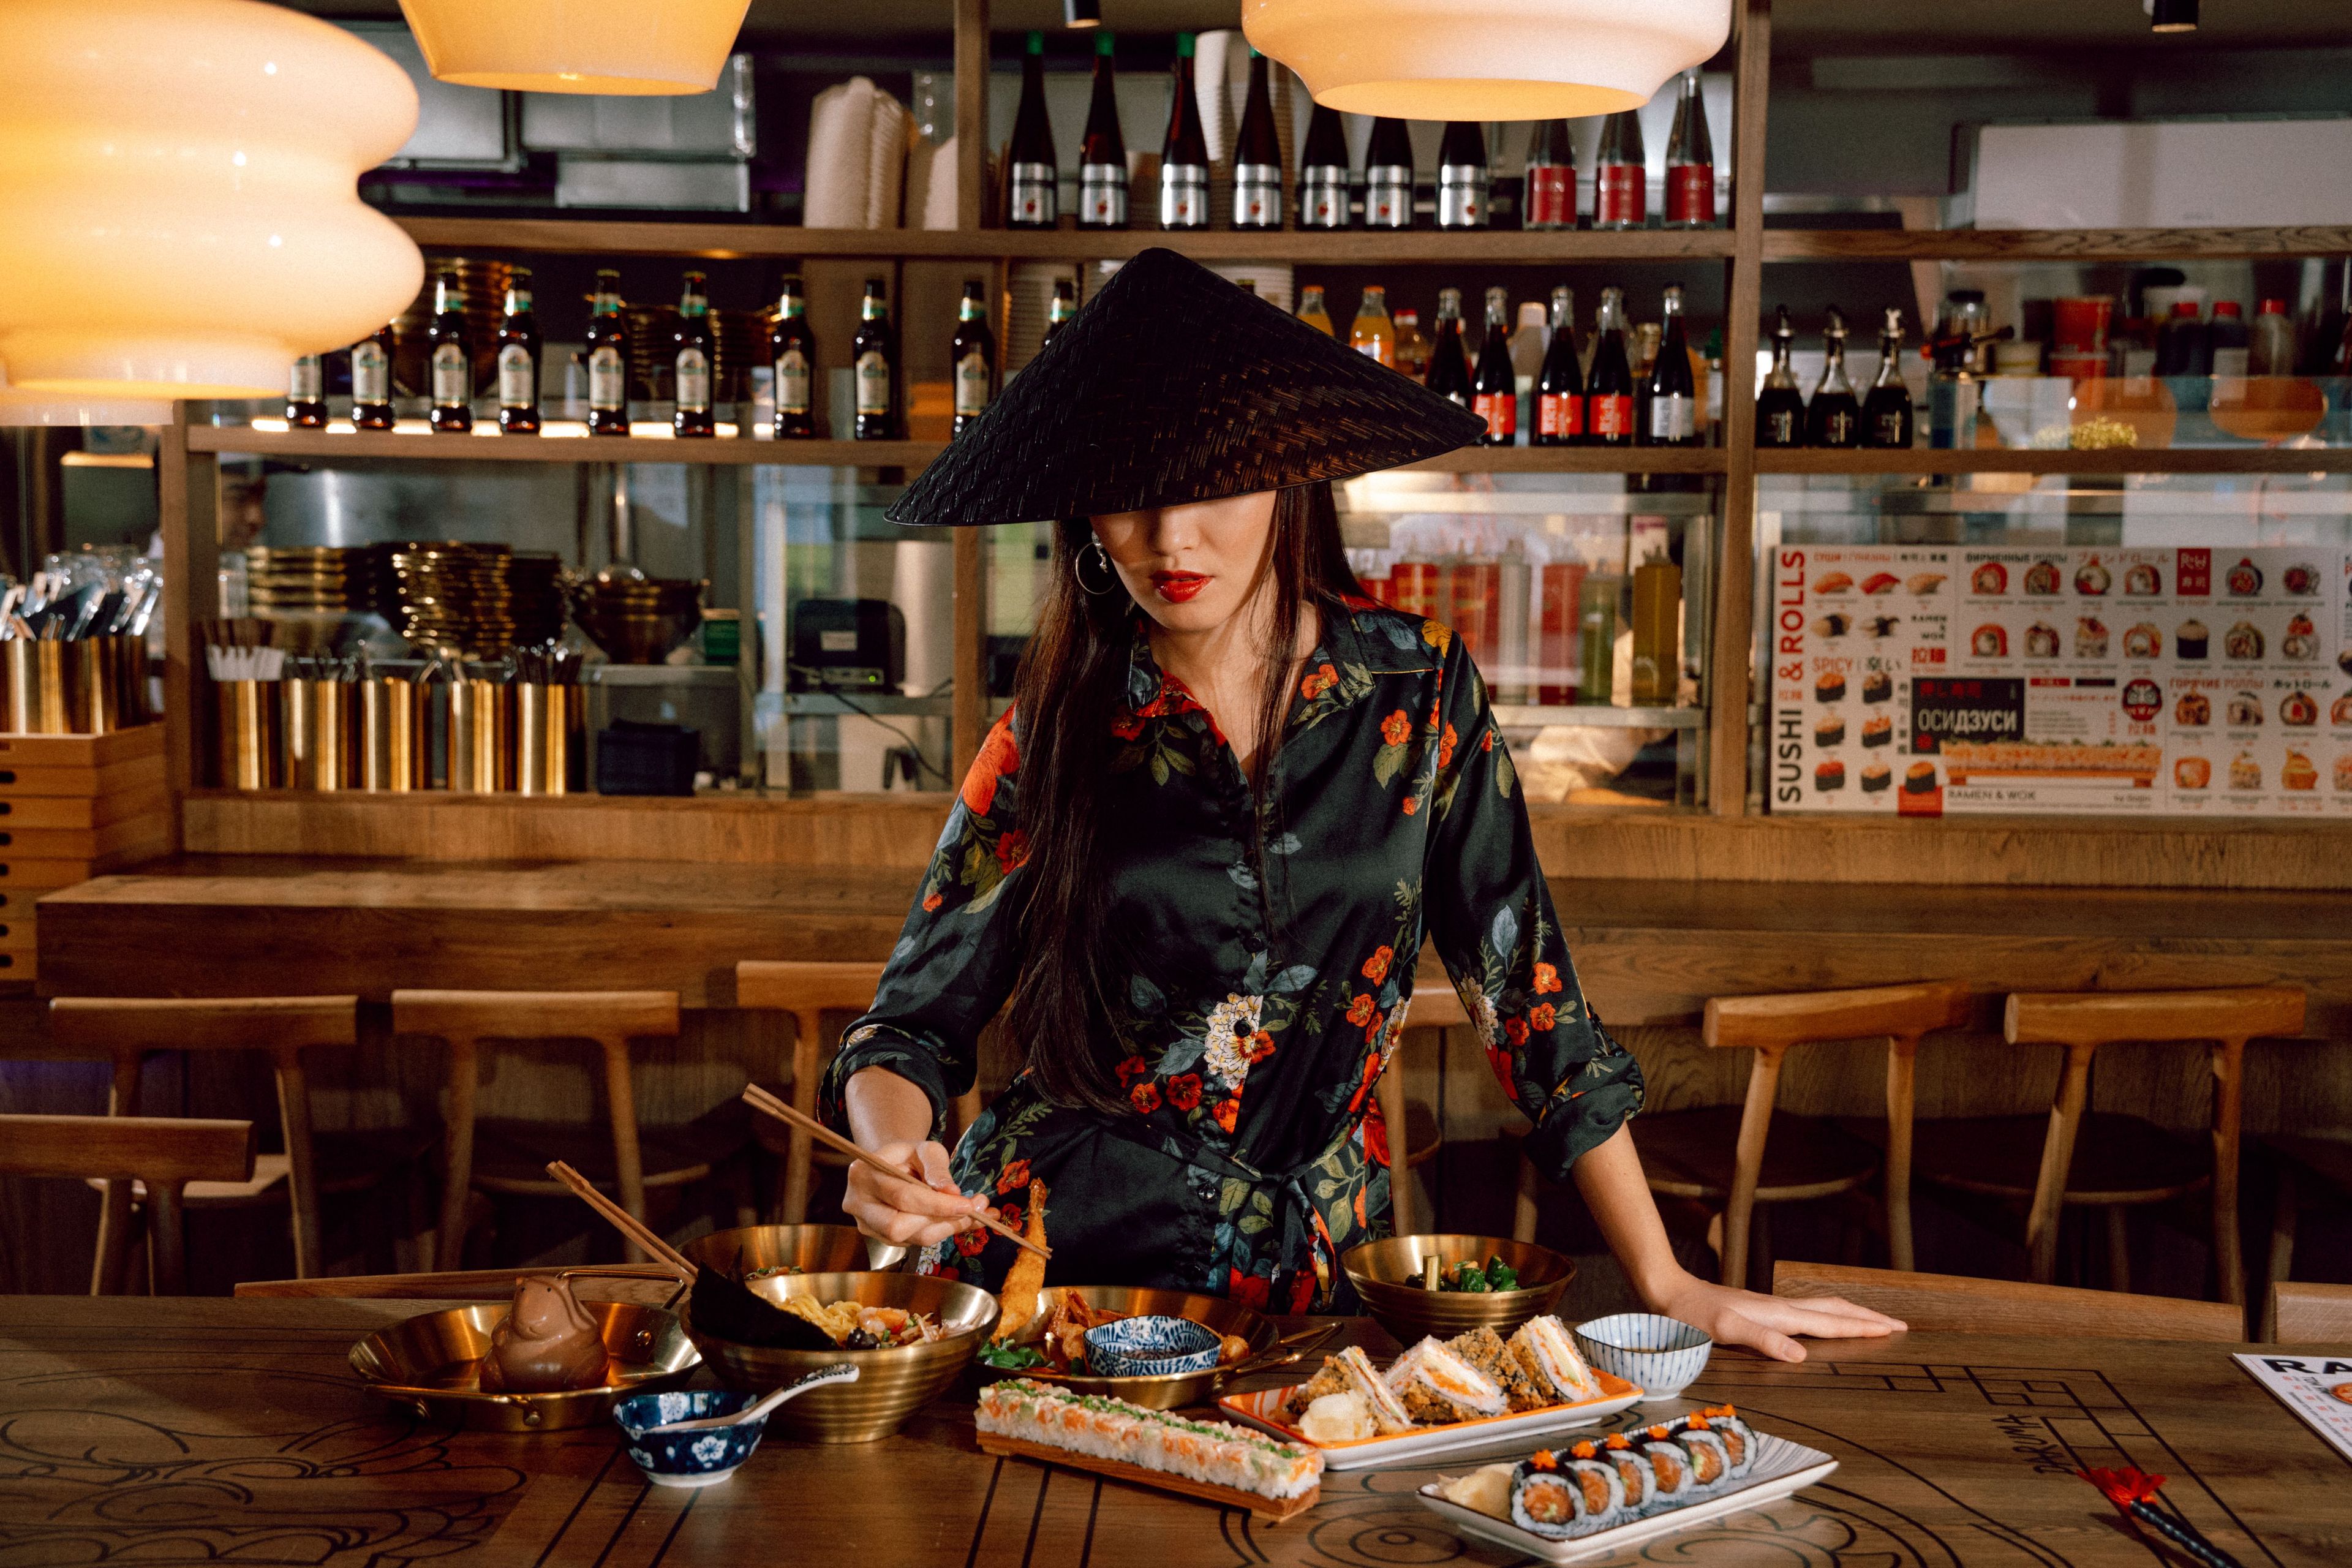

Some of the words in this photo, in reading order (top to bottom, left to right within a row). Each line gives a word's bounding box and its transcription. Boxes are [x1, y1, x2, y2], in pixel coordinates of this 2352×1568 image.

[1781, 552, 1804, 654] ROLLS
[1778, 662, 1803, 681] &
[1813, 657, 1852, 672] SPICY
[2169, 679, 2220, 690] ГОРЯЧИЕ
[2224, 679, 2264, 690] РОЛЛЫ
[1918, 708, 2018, 734] ОСИДЗУСИ
[1779, 709, 1802, 802] SUSHI
[1948, 791, 1992, 799] RAMEN
[2008, 791, 2035, 800] WOK
[2261, 1359, 2352, 1374] RA
[1991, 1414, 2077, 1475] DARUMA
